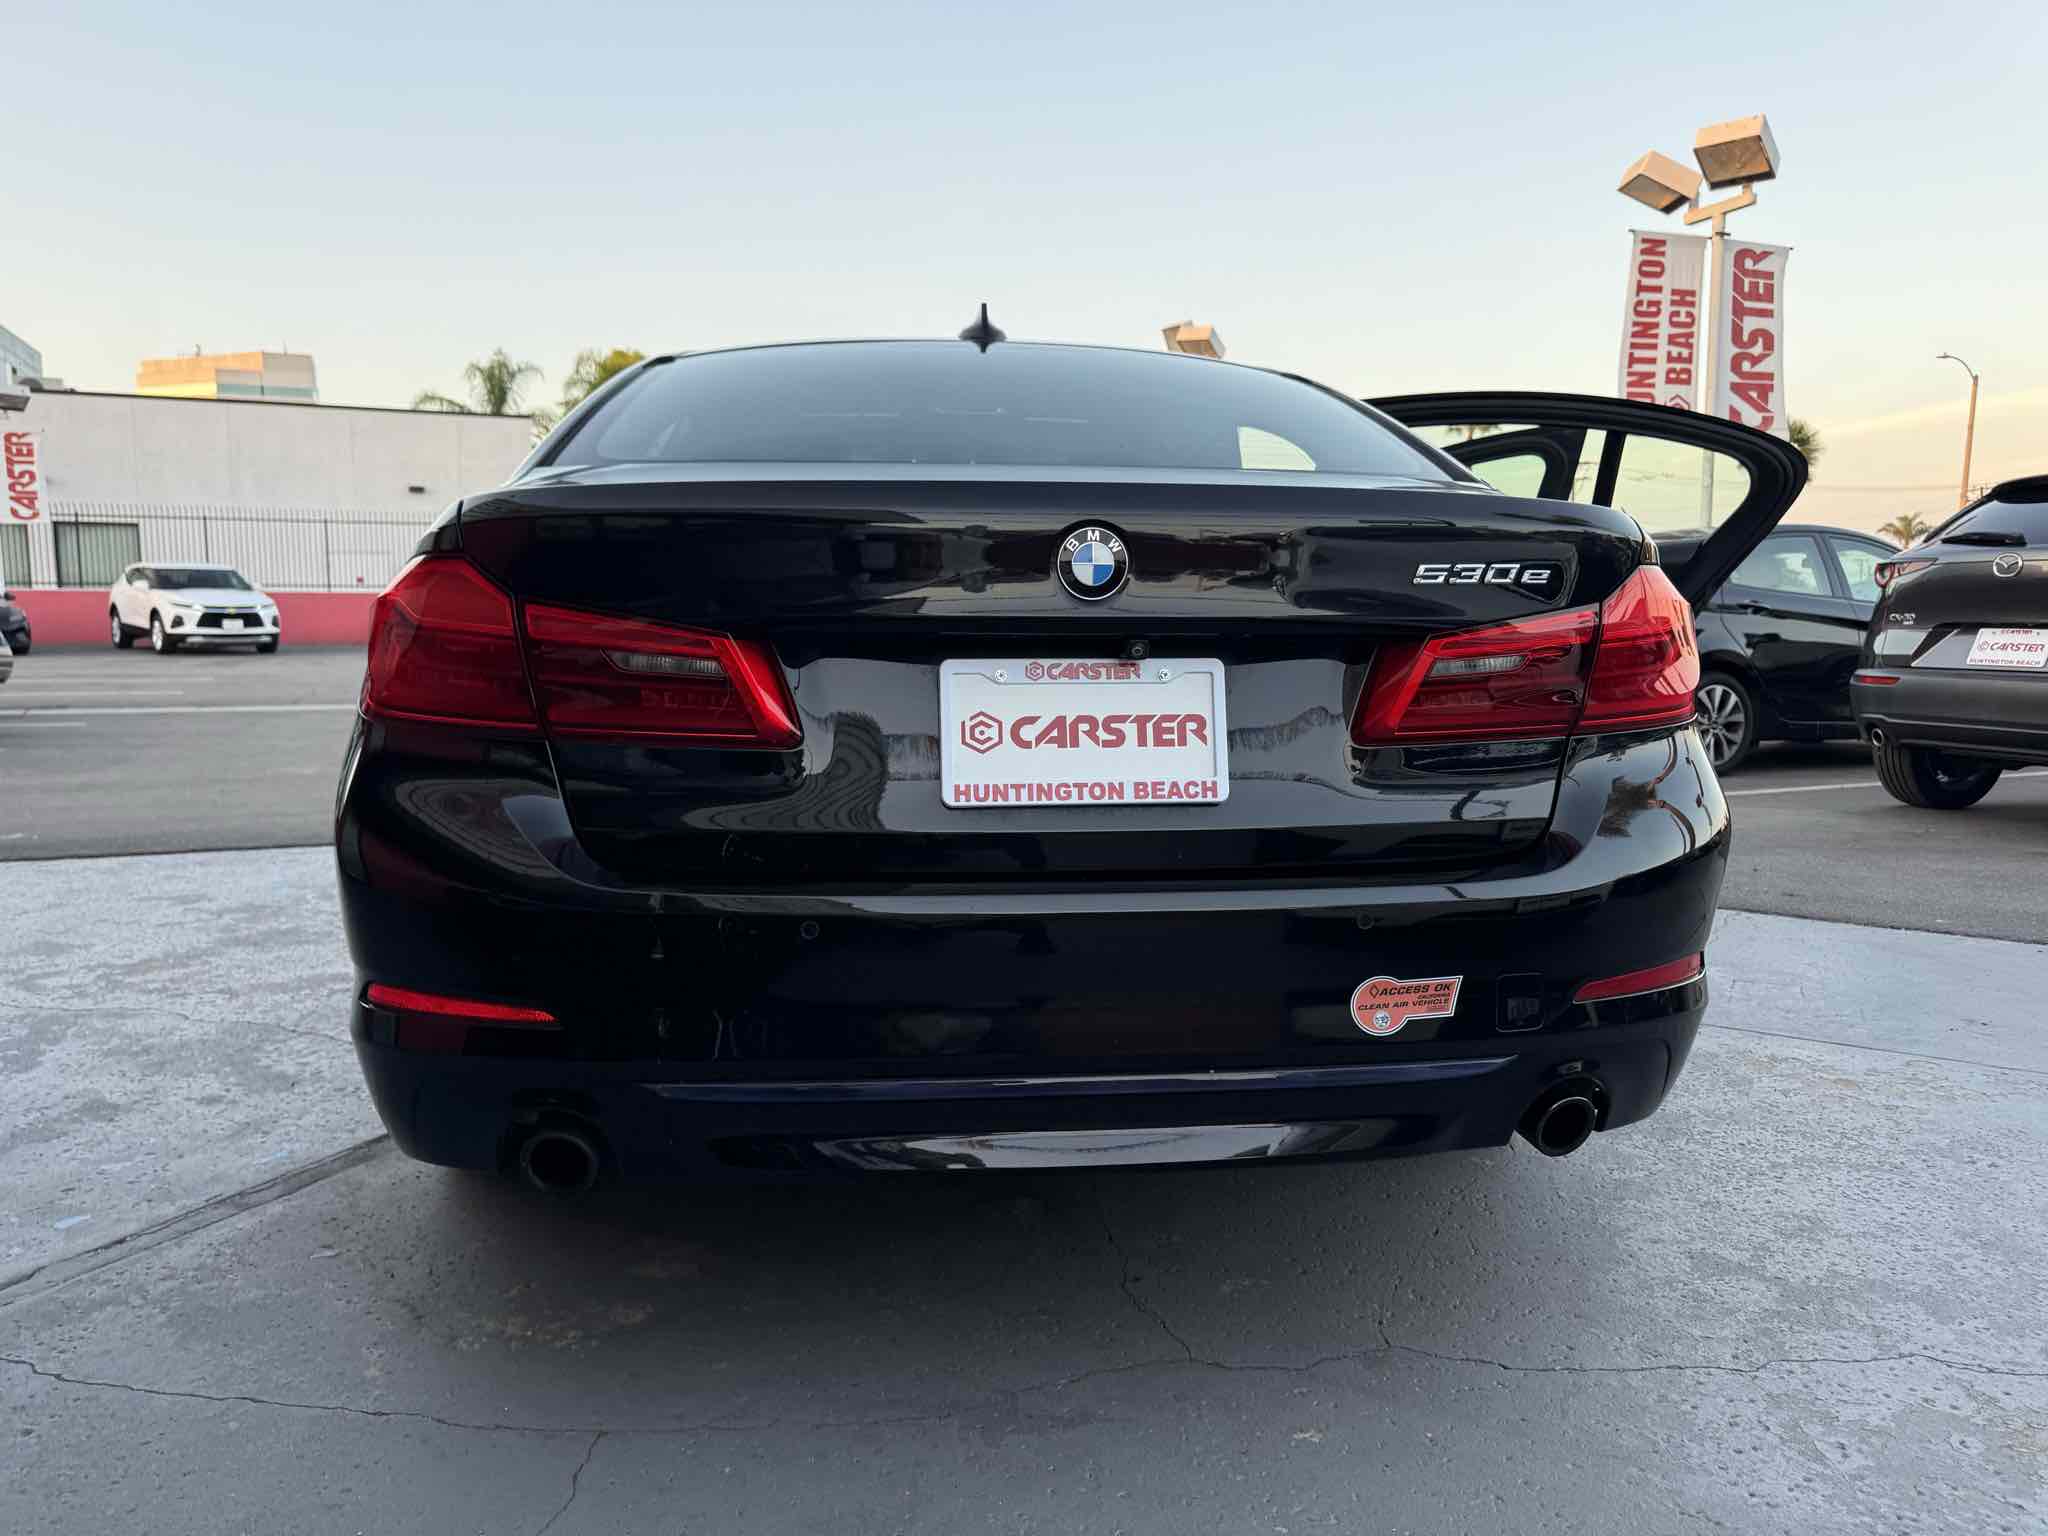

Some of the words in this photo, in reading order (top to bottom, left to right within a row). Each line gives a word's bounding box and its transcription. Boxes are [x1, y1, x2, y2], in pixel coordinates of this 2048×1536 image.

[1665, 288, 1697, 385] BEACH
[4, 432, 39, 520] CARSTER
[1066, 529, 1122, 553] BMW
[1412, 563, 1551, 584] 530e
[1990, 642, 2045, 652] CARSTER
[1047, 662, 1142, 680] CARSTER
[1010, 713, 1208, 749] CARSTER
[954, 782, 1125, 802] HUNTINGTON
[1133, 780, 1219, 800] BEACH
[1379, 985, 1430, 996] ACCESS
[1435, 983, 1451, 992] OK
[1358, 1002, 1390, 1010] CLEAN
[1392, 1000, 1409, 1008] AIR
[1412, 998, 1449, 1006] VEHICLE
